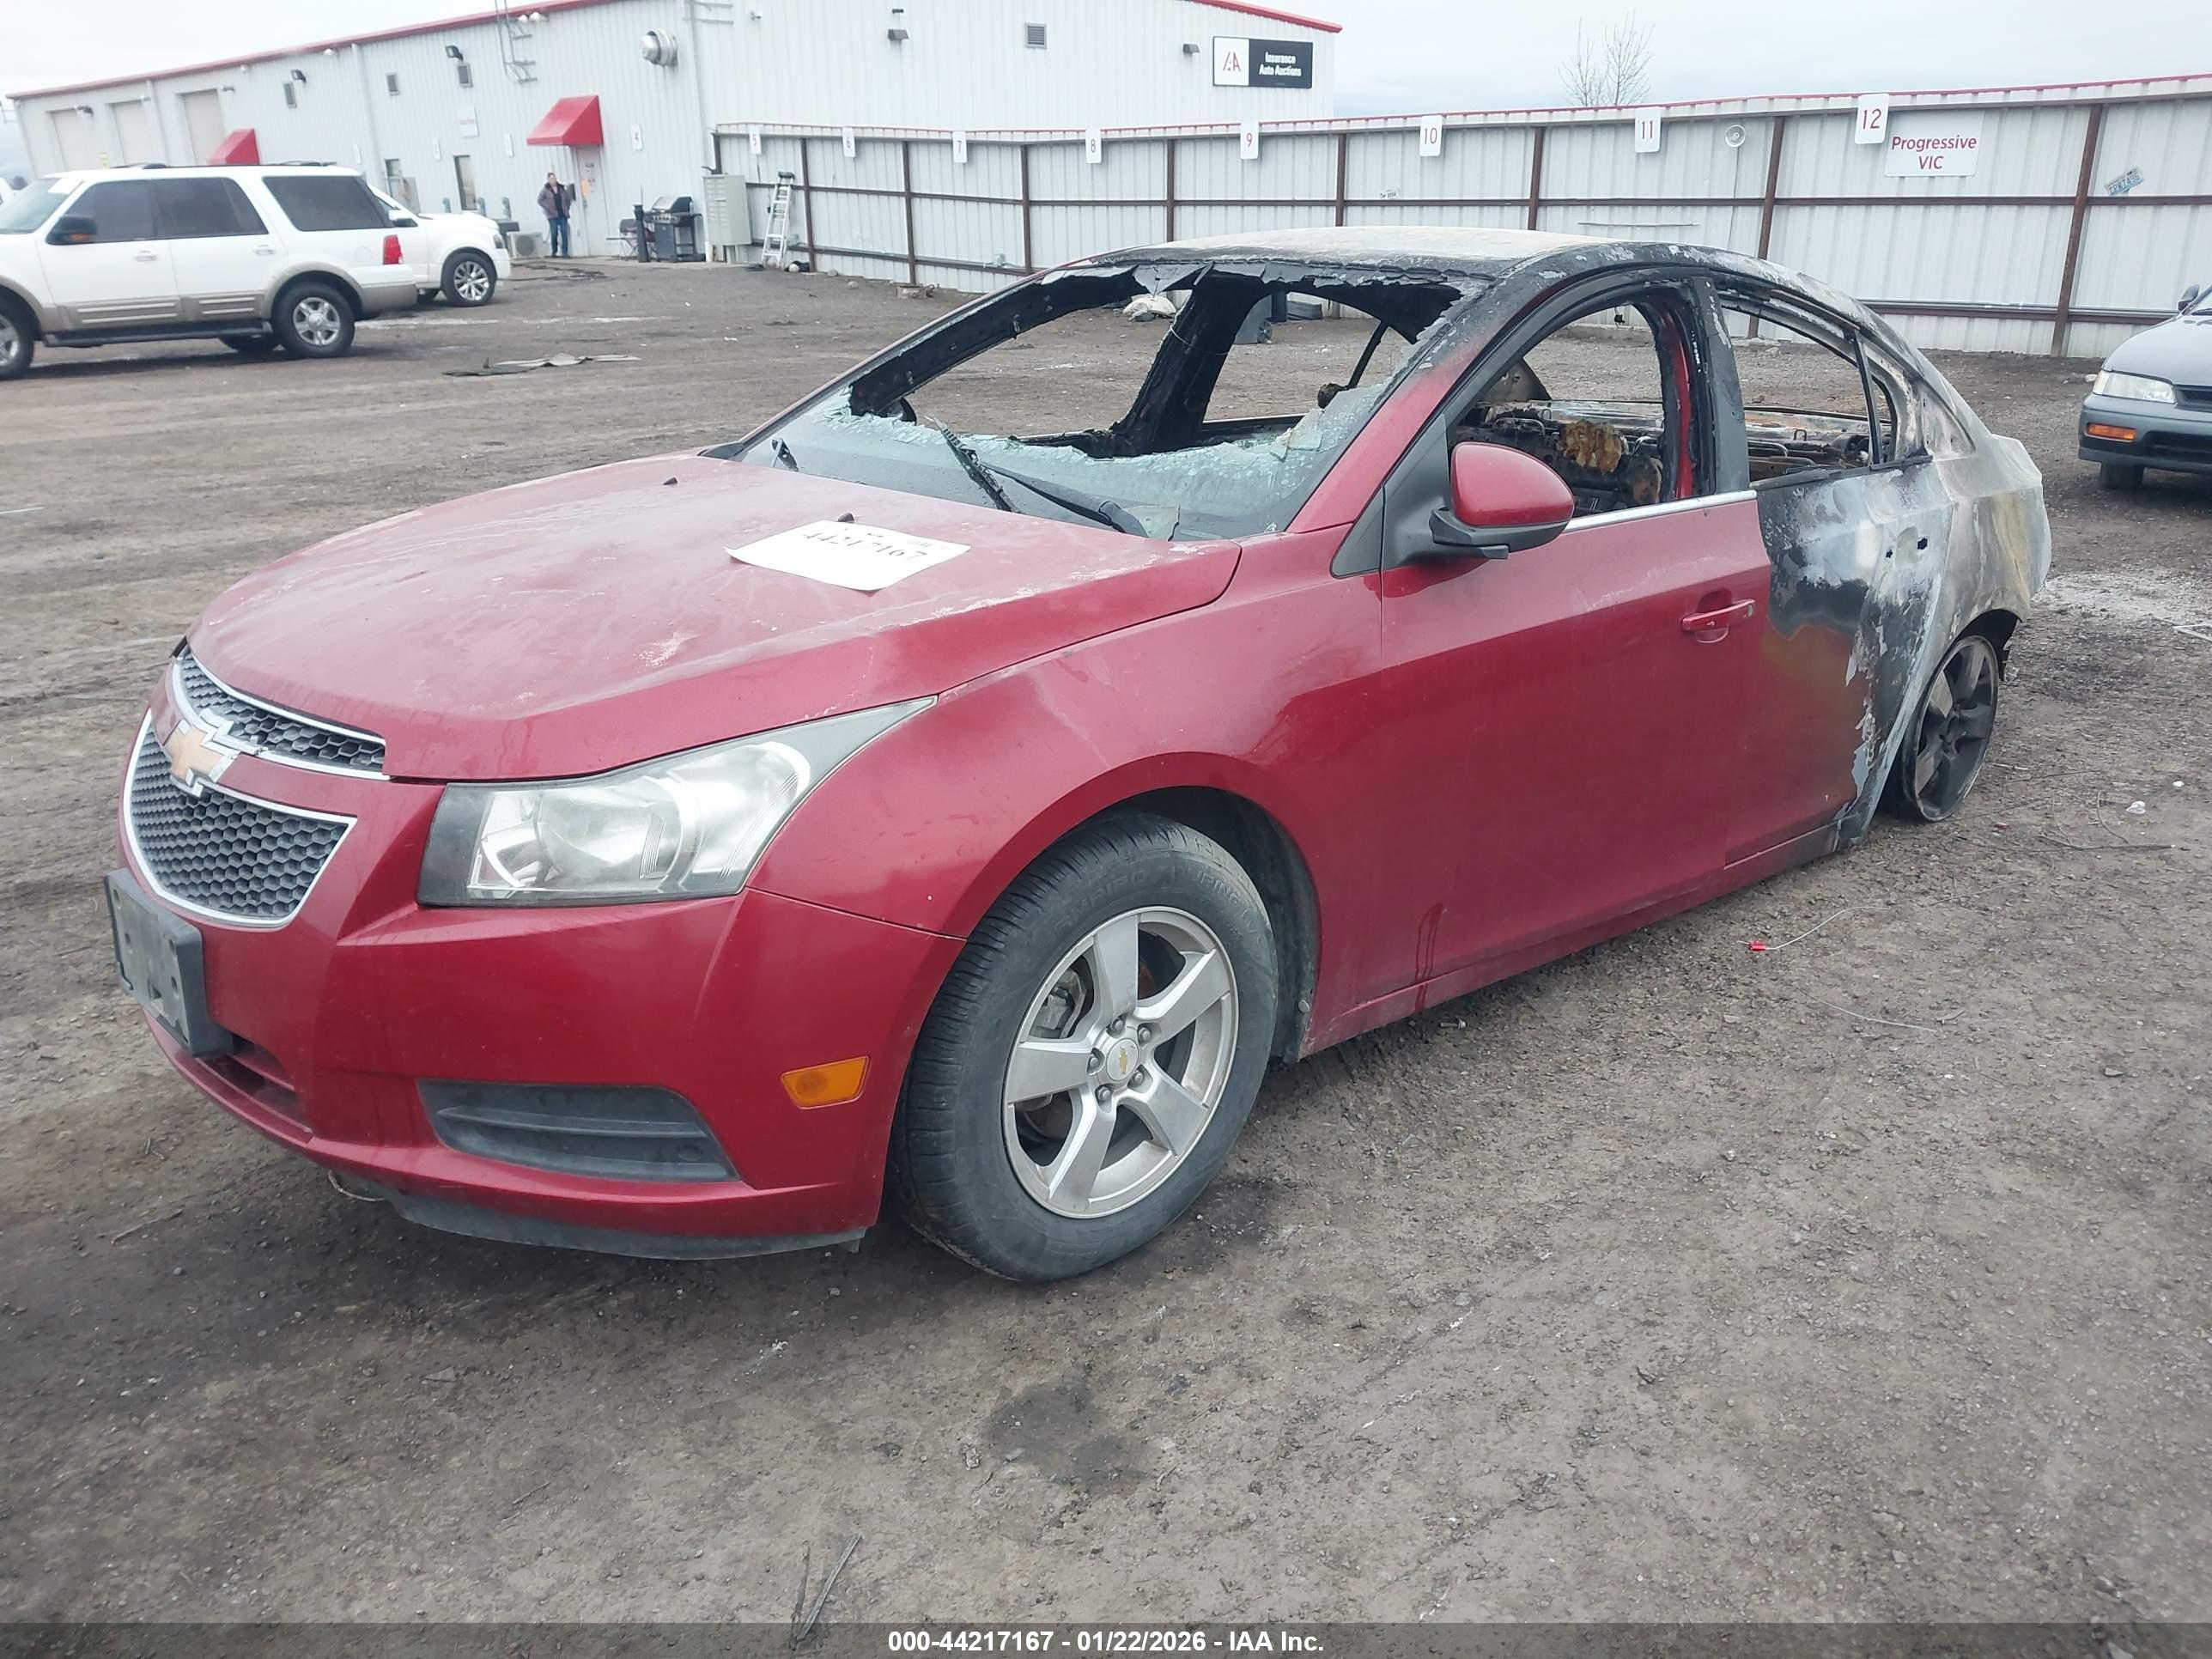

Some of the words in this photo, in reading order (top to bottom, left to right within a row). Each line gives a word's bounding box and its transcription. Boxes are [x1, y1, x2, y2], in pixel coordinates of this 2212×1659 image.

[1265, 52, 1296, 64] Insurance
[1259, 64, 1274, 76] Auto
[1275, 64, 1302, 76] Auctions
[1862, 108, 1882, 130] 12
[1424, 127, 1437, 144] 10
[1641, 120, 1653, 139] 11
[957, 140, 963, 153] 7
[1091, 138, 1097, 153] 8
[1246, 133, 1253, 148] 9
[1892, 135, 1978, 152] Progressive
[1918, 155, 1944, 170] VIC
